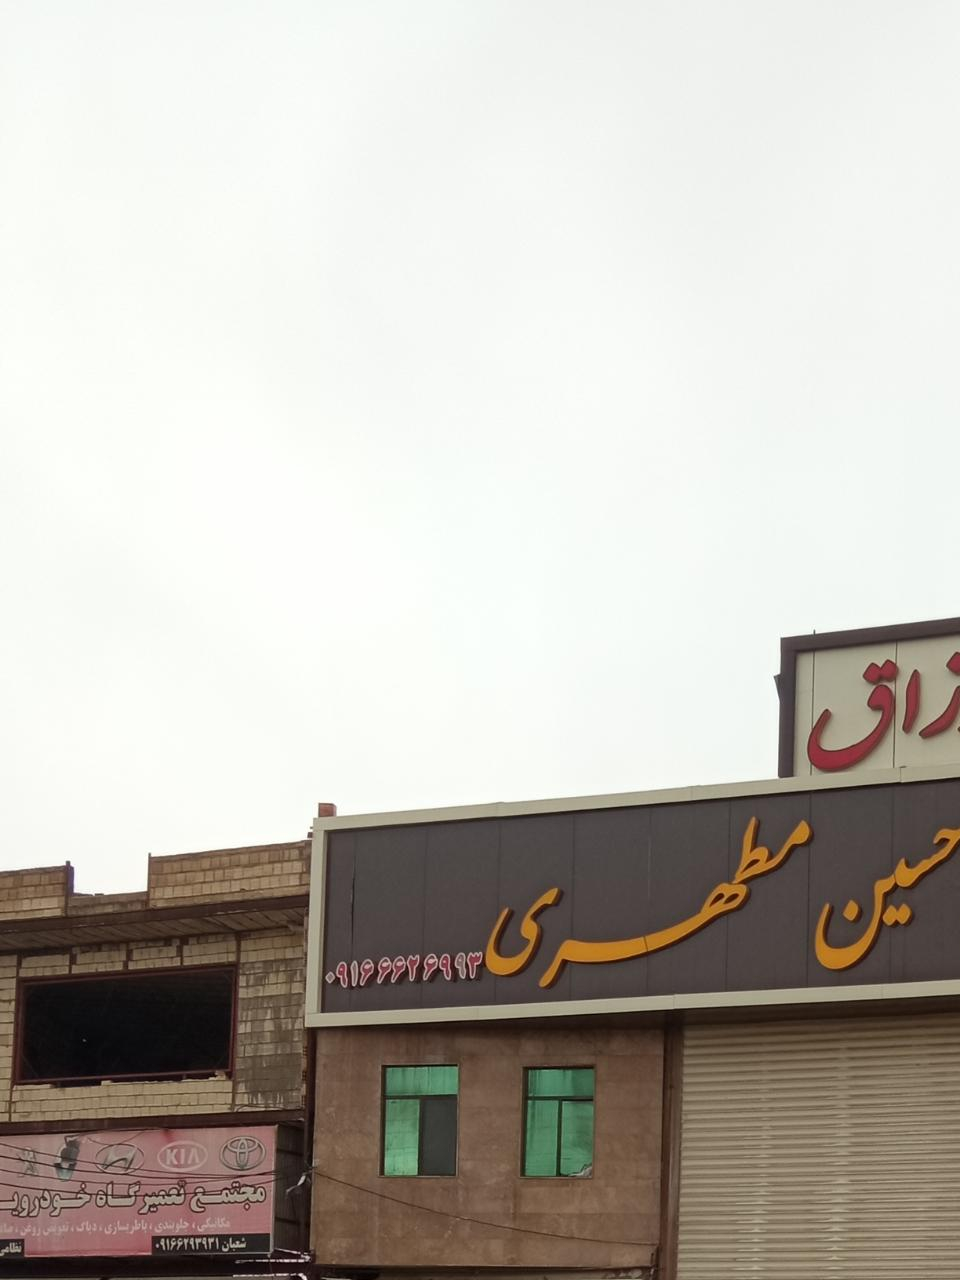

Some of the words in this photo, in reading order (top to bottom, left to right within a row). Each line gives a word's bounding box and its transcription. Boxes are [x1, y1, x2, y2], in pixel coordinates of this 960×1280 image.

[484, 816, 813, 989] مطهری
[324, 951, 484, 988] ۰۹۱۶۶۶۲۶۹۹۳
[165, 1147, 201, 1166] KIA
[189, 1180, 267, 1214] مجتمع
